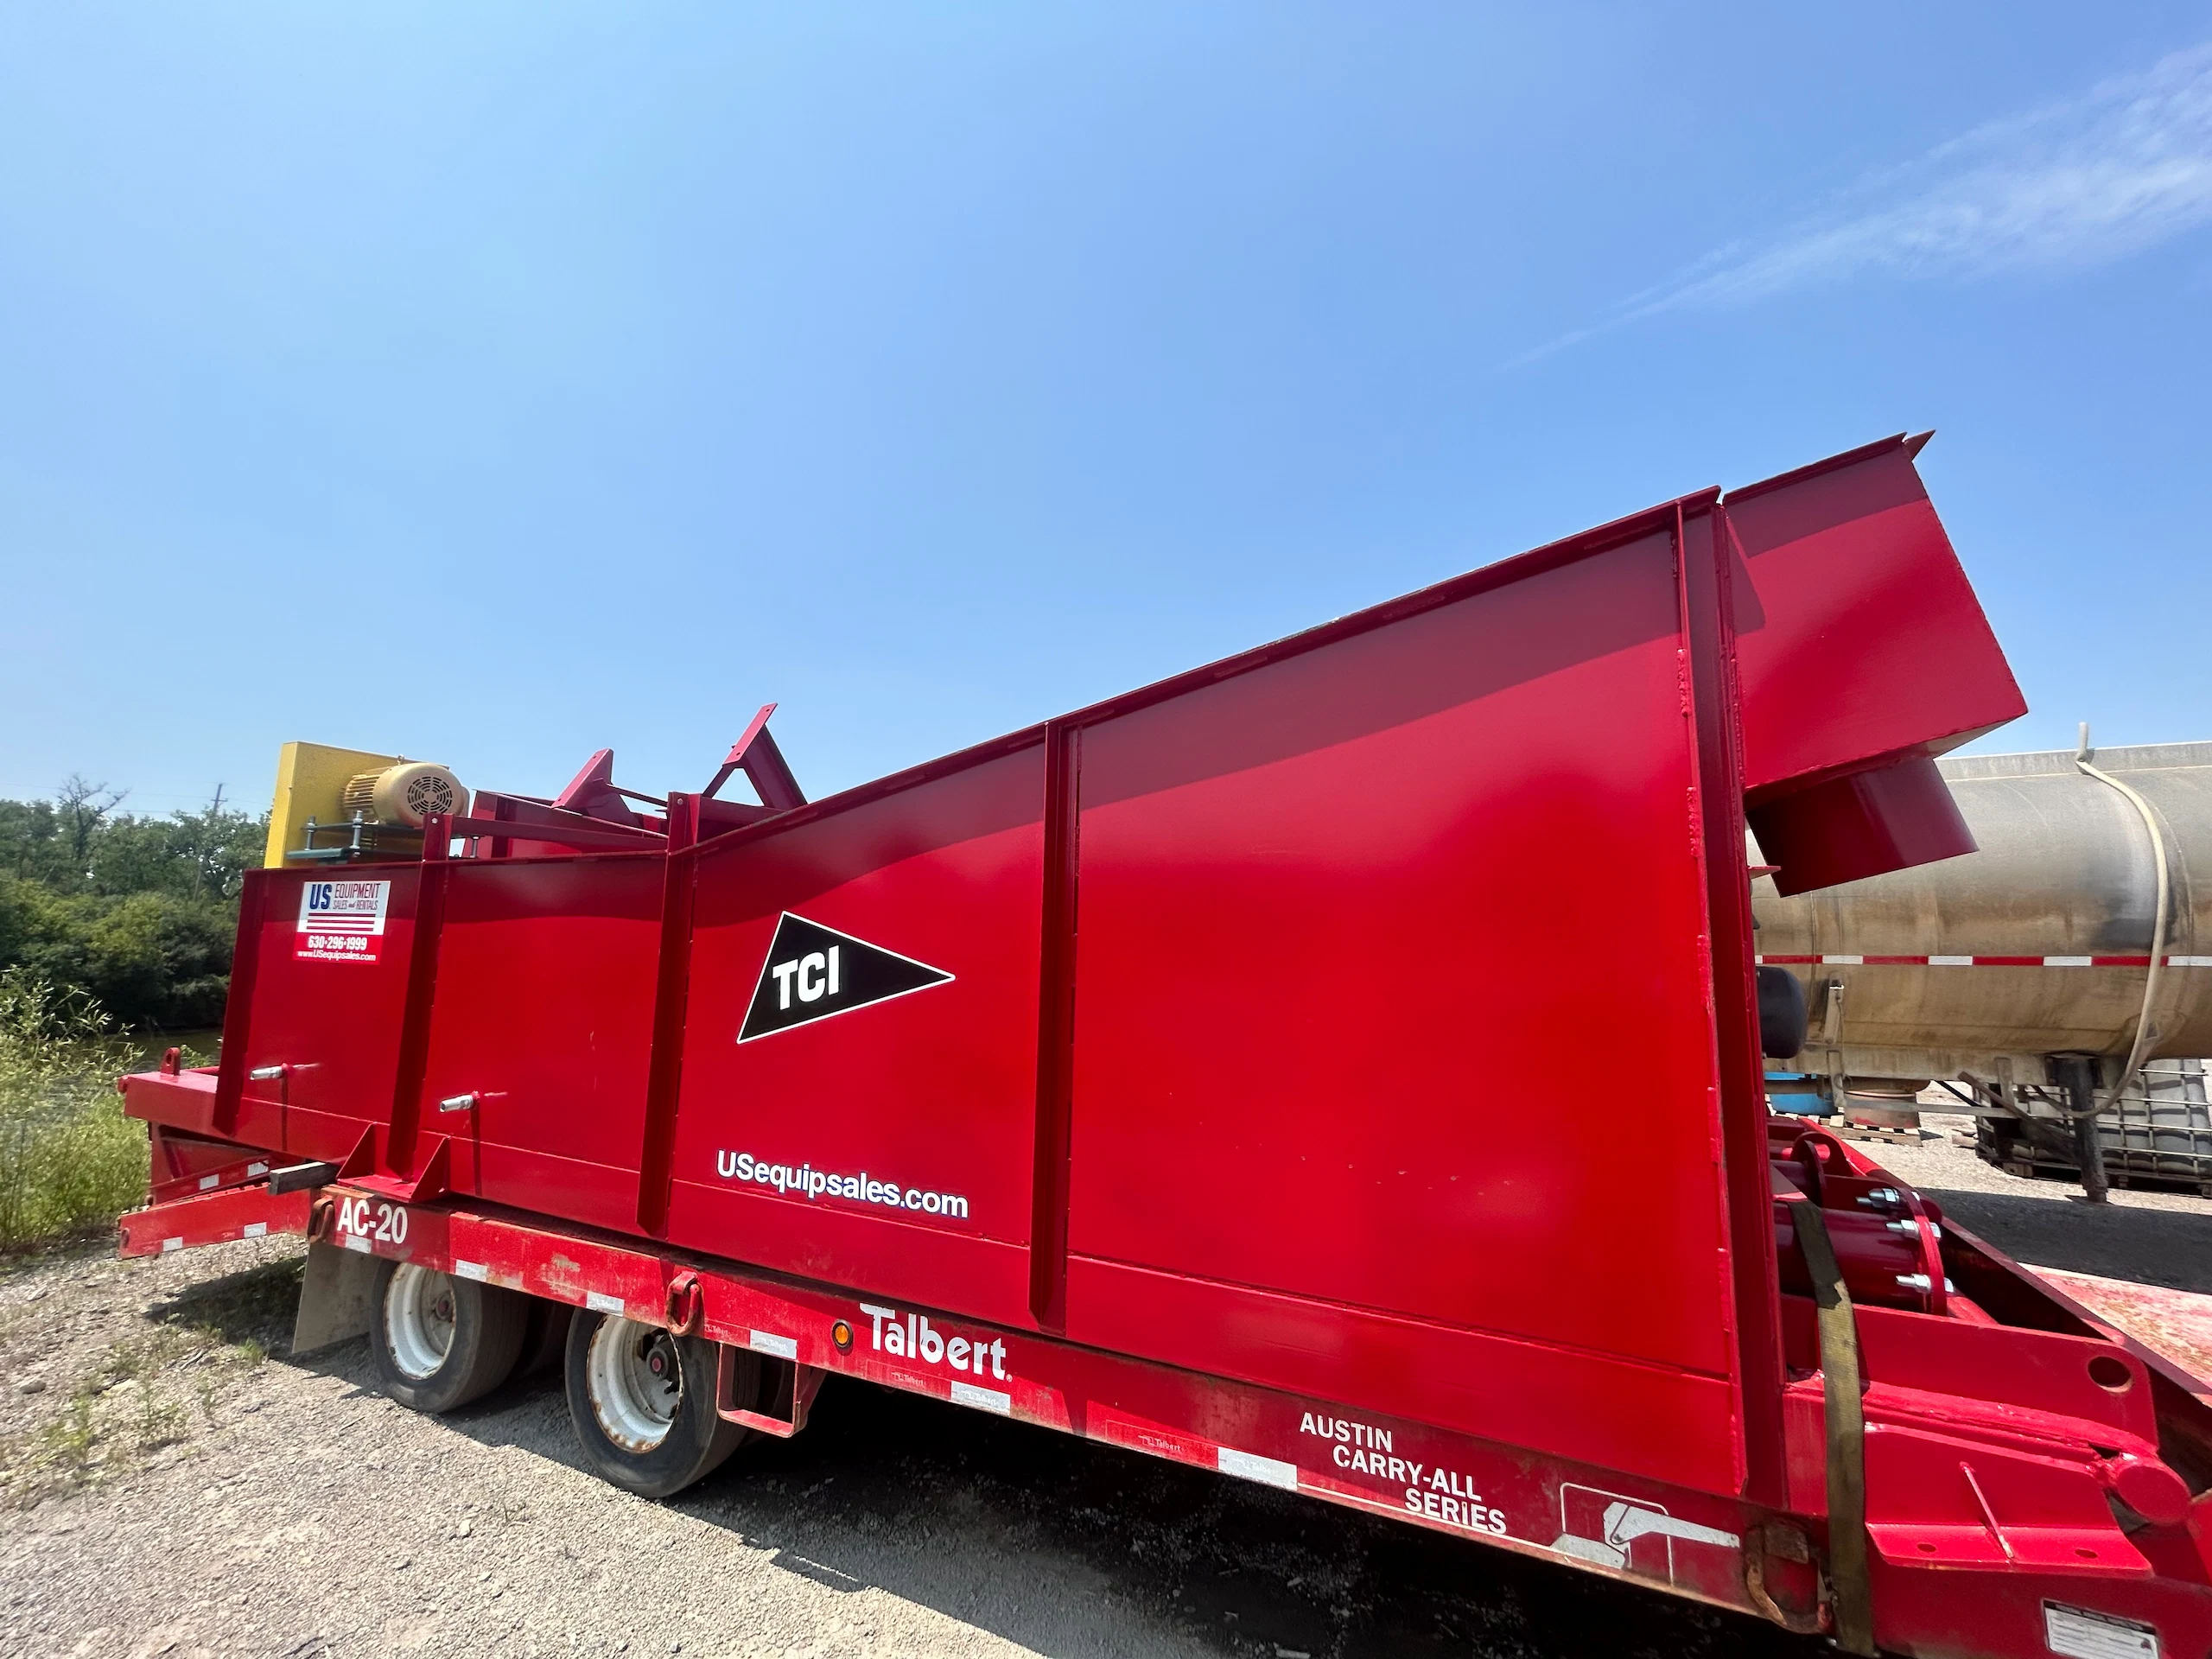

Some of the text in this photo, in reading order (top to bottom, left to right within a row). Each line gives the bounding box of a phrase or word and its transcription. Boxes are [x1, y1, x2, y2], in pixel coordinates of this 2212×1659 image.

[309, 883, 381, 909] US EQUIPMENT
[333, 899, 348, 910] SALES
[356, 899, 378, 910] RENTALS
[297, 950, 377, 962] www.USequipsales.com
[772, 945, 839, 1010] TCI
[716, 1149, 969, 1217] USequipsales.com
[336, 1197, 408, 1244] AC-20
[860, 1302, 1007, 1381] Talbert
[1154, 1438, 1181, 1452] Talbert
[1300, 1412, 1392, 1452] AUSTIN
[1332, 1444, 1482, 1502] CARRY-ALL
[1404, 1487, 1507, 1535] SERIES
